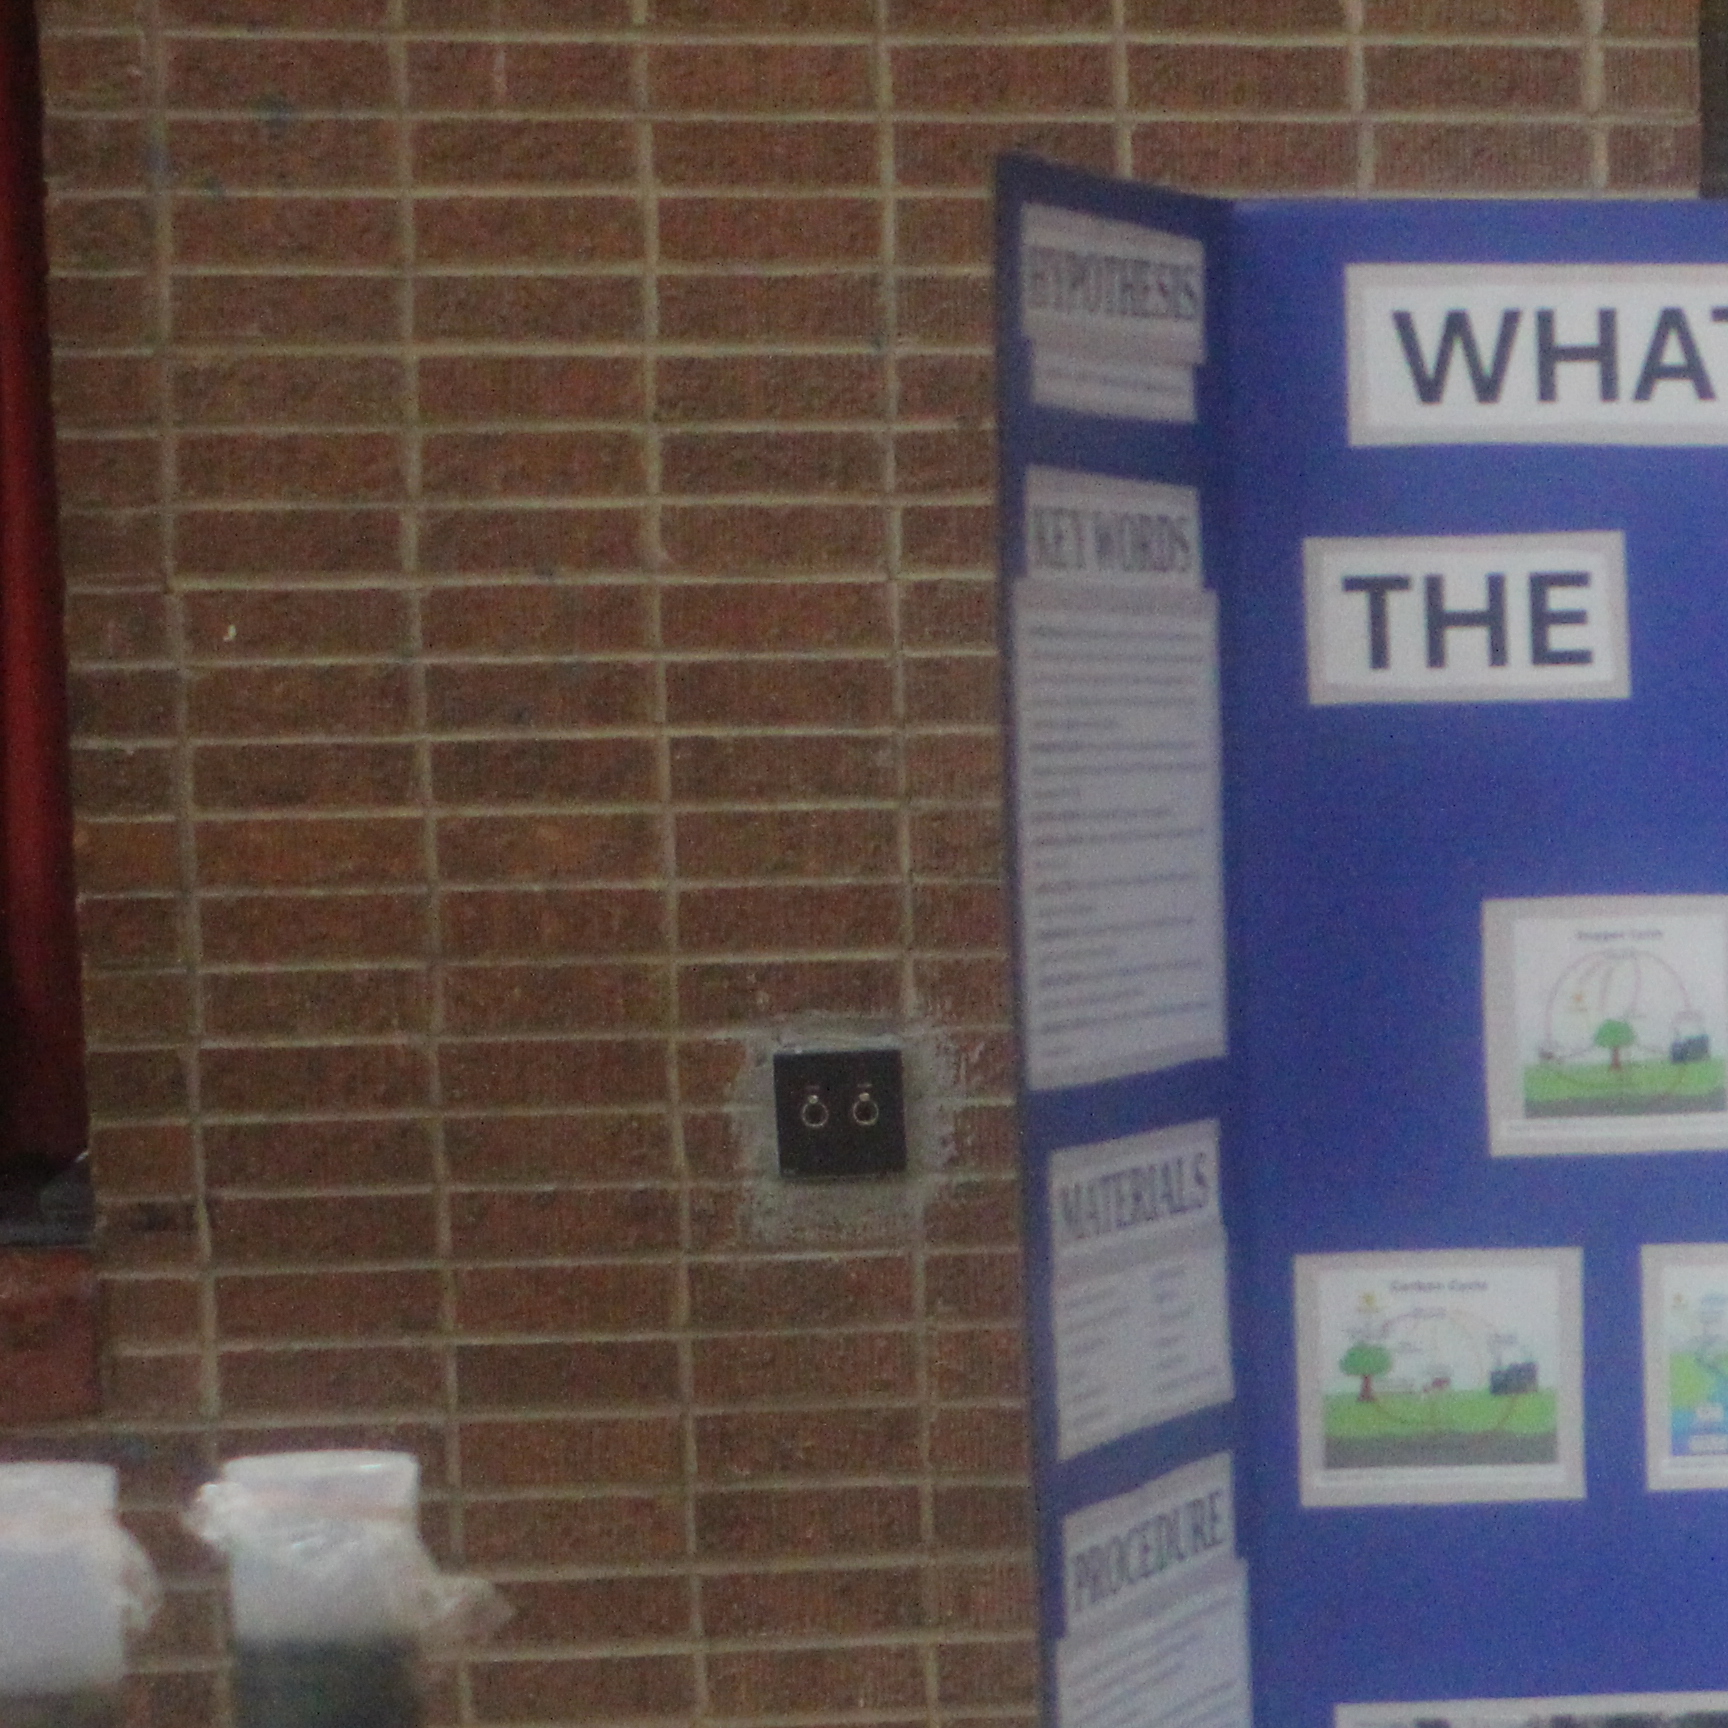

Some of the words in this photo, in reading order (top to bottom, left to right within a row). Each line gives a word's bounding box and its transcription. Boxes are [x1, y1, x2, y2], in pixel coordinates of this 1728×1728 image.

[1026, 244, 1198, 320] HYPOTHESIS
[1093, 507, 1193, 573] WORDS
[1342, 571, 1596, 671] THE
[1058, 1150, 1209, 1240] MATERIALS
[1072, 1490, 1224, 1611] PROCEDURE
